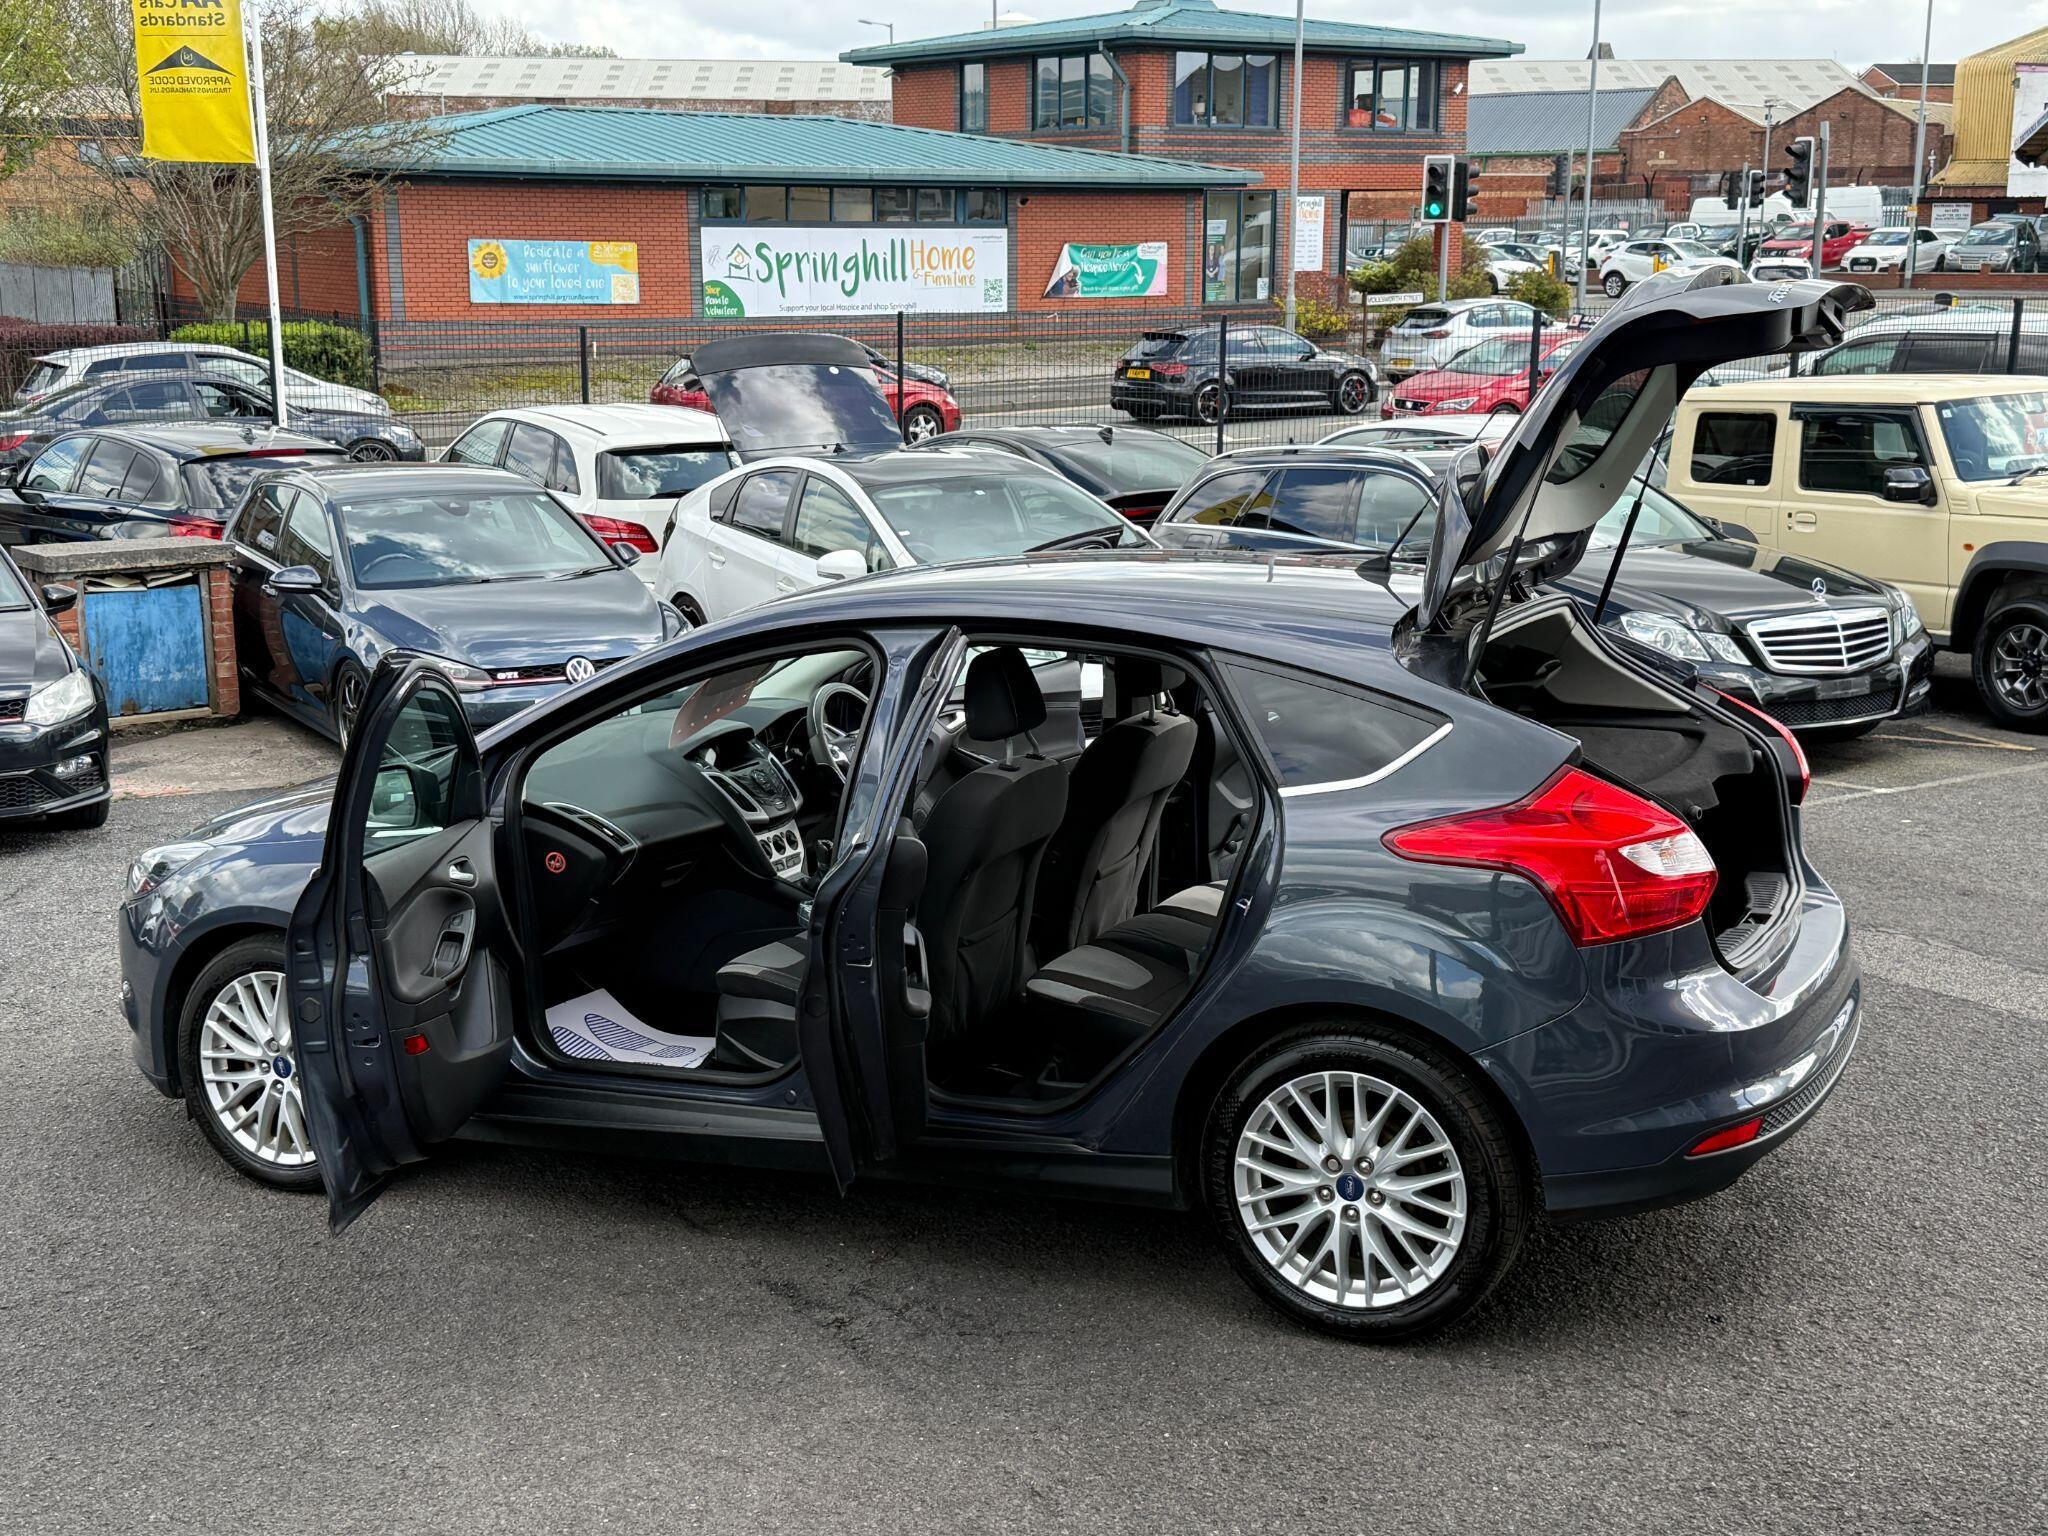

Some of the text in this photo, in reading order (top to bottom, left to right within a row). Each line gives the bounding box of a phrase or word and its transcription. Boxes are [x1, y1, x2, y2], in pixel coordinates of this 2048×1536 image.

[523, 245, 584, 258] Dedicate a
[525, 258, 580, 273] sunflower
[755, 238, 907, 298] Springhill
[910, 239, 975, 270] Home
[507, 275, 605, 293] to your loved one
[924, 270, 976, 286] Furniture
[779, 304, 804, 312] Support
[836, 303, 859, 312] Hospice
[873, 302, 889, 311] shop
[889, 302, 917, 311] Springhill
